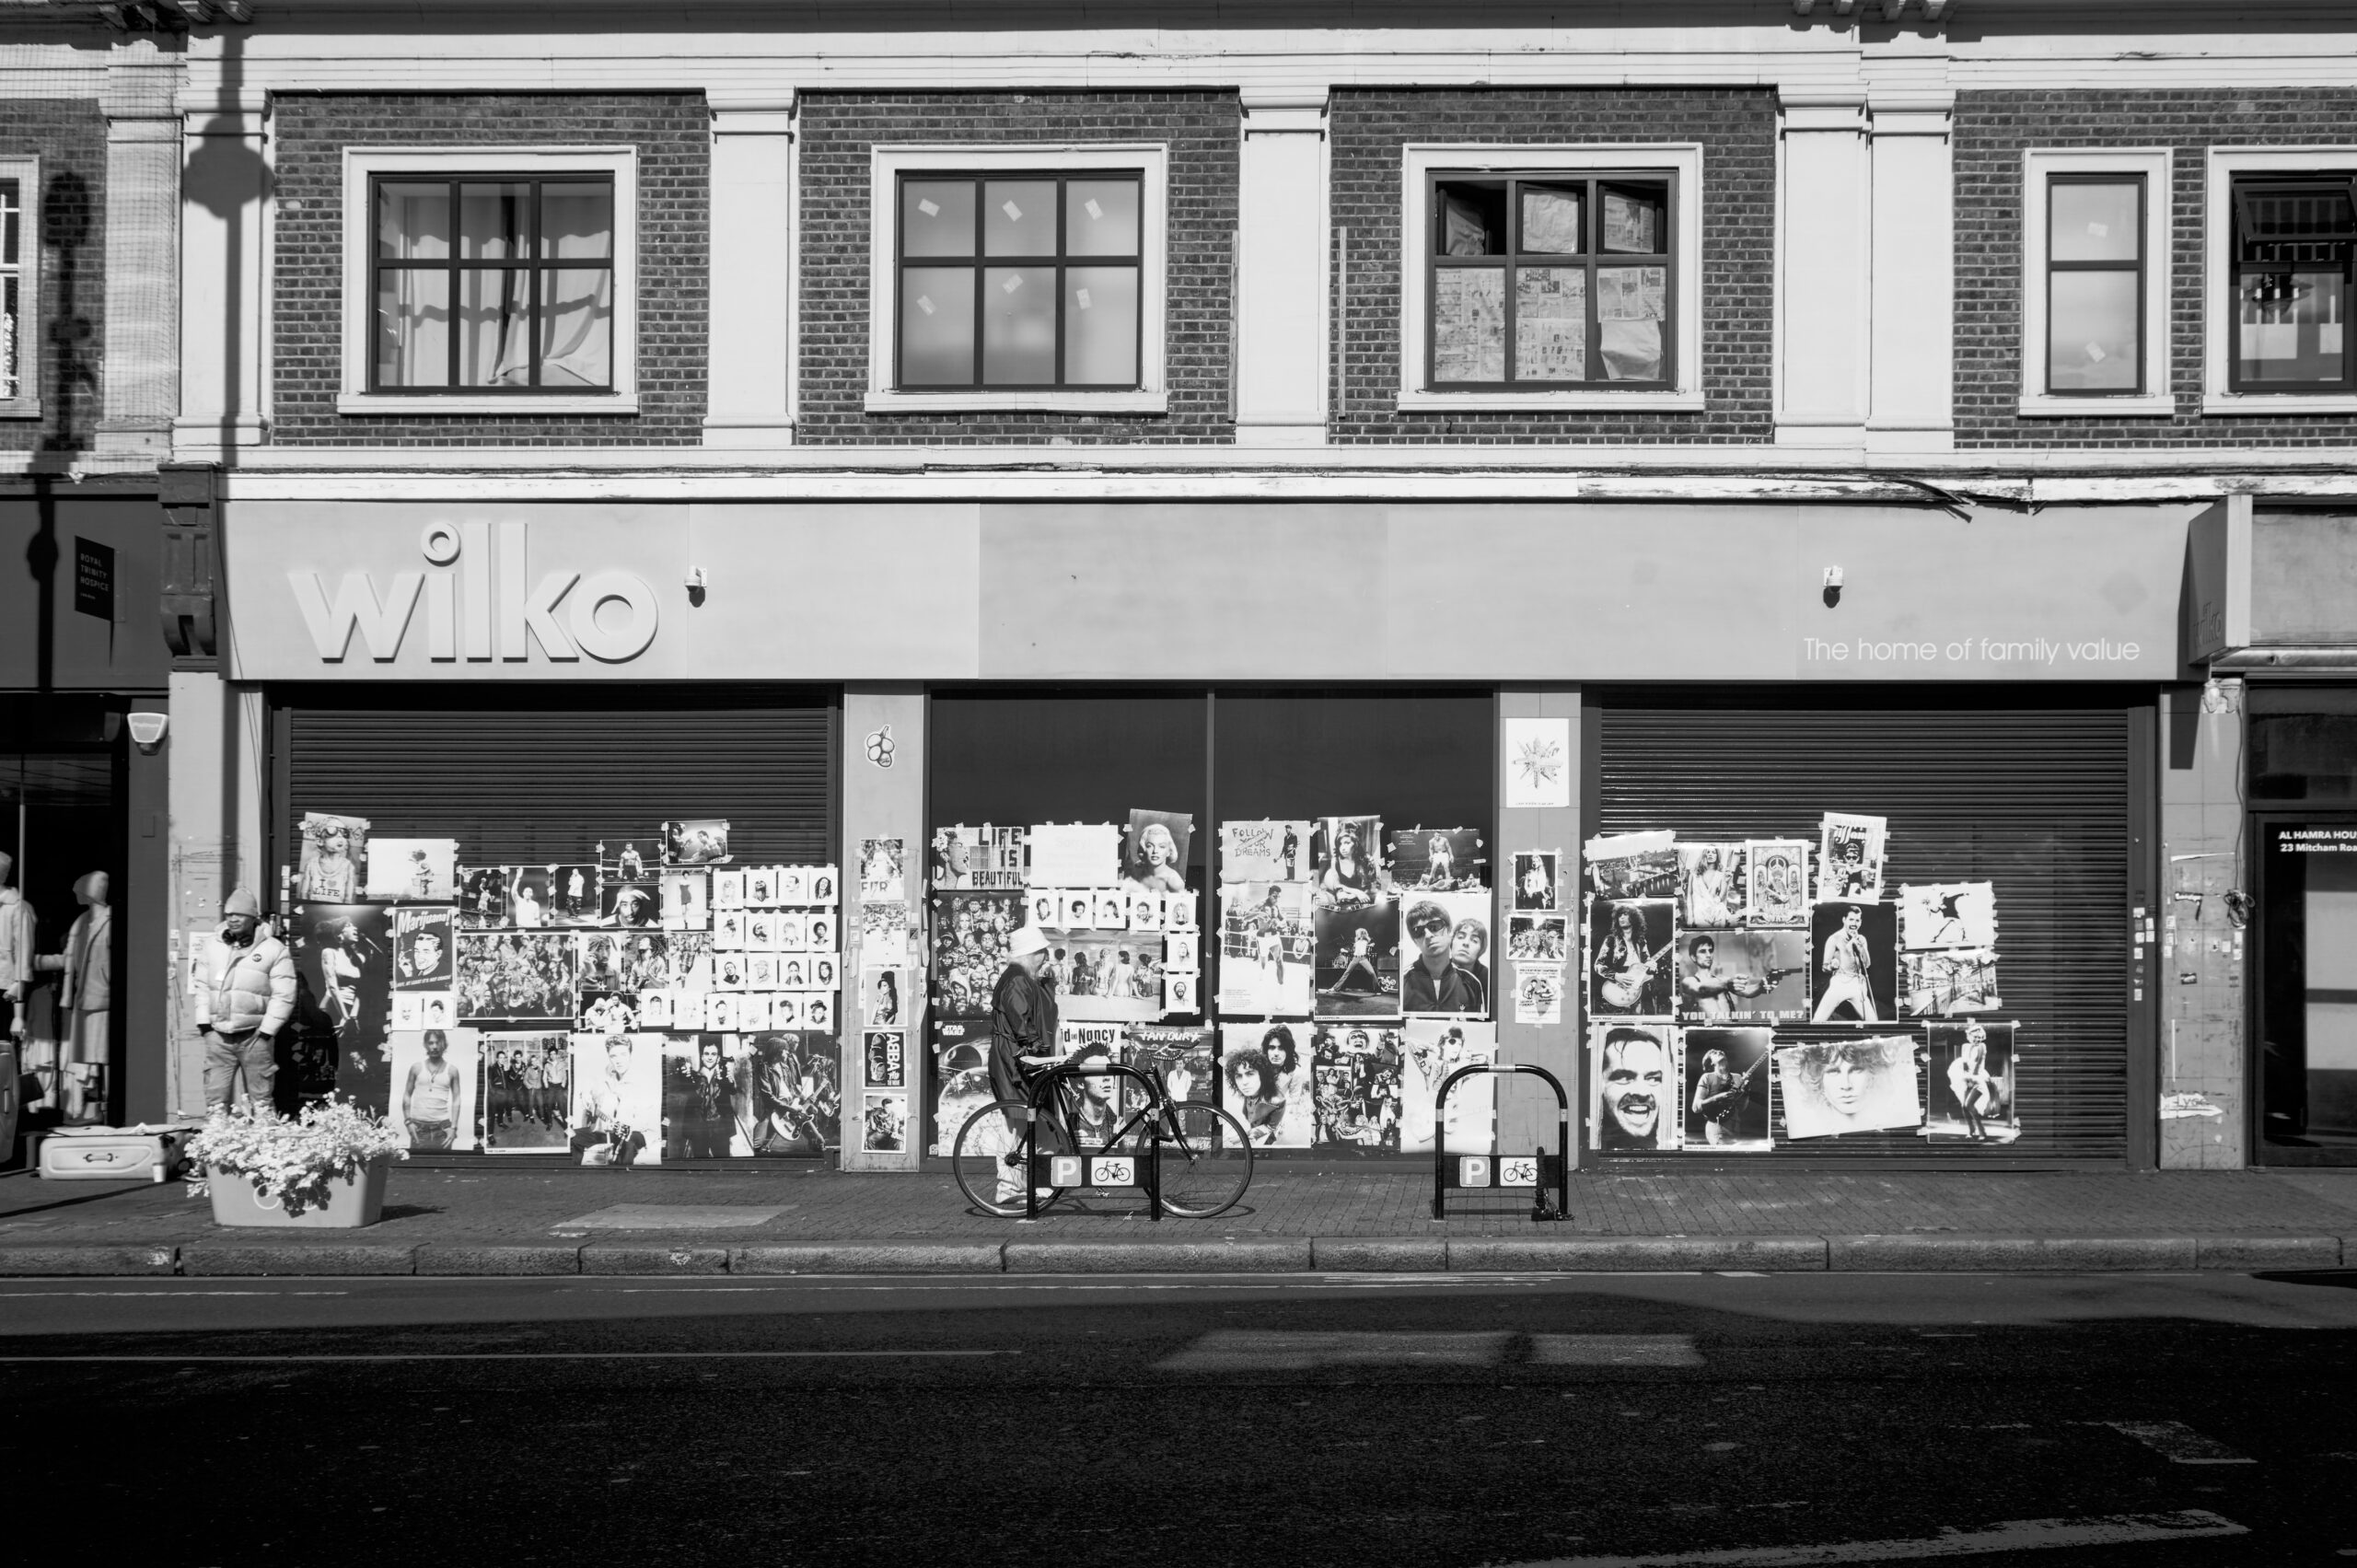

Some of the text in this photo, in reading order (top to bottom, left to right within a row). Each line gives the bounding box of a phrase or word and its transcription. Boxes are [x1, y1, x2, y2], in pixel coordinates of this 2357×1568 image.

[80, 552, 102, 567] ROYAL
[80, 563, 108, 579] TRINITY
[80, 575, 110, 591] HOSPICE
[286, 521, 658, 664] wilko
[1804, 637, 2141, 666] The home of family value
[979, 828, 1022, 846] LIFE
[1232, 828, 1273, 840] FOLLOW
[1239, 834, 1266, 849] YUR
[2279, 830, 2357, 840] AL HAMRA HOU
[1235, 848, 1271, 857] DREAMS
[2281, 842, 2293, 853] 23
[2295, 842, 2338, 853] Mitcham
[1001, 850, 1017, 867] IS
[319, 878, 326, 889] I
[972, 870, 1023, 887] BEAUTIFUL
[313, 887, 340, 898] LIFE
[396, 909, 451, 938] Marijuana!
[1682, 1010, 1805, 1020] YOU TALKIN' TO ME?
[942, 1028, 965, 1036] WARS
[1061, 1028, 1071, 1042] id
[1078, 1028, 1115, 1044] Nancy
[1167, 1030, 1198, 1043] DURY
[887, 1032, 900, 1072] ABBA
[1057, 1158, 1077, 1185] P
[1466, 1159, 1486, 1185] P
